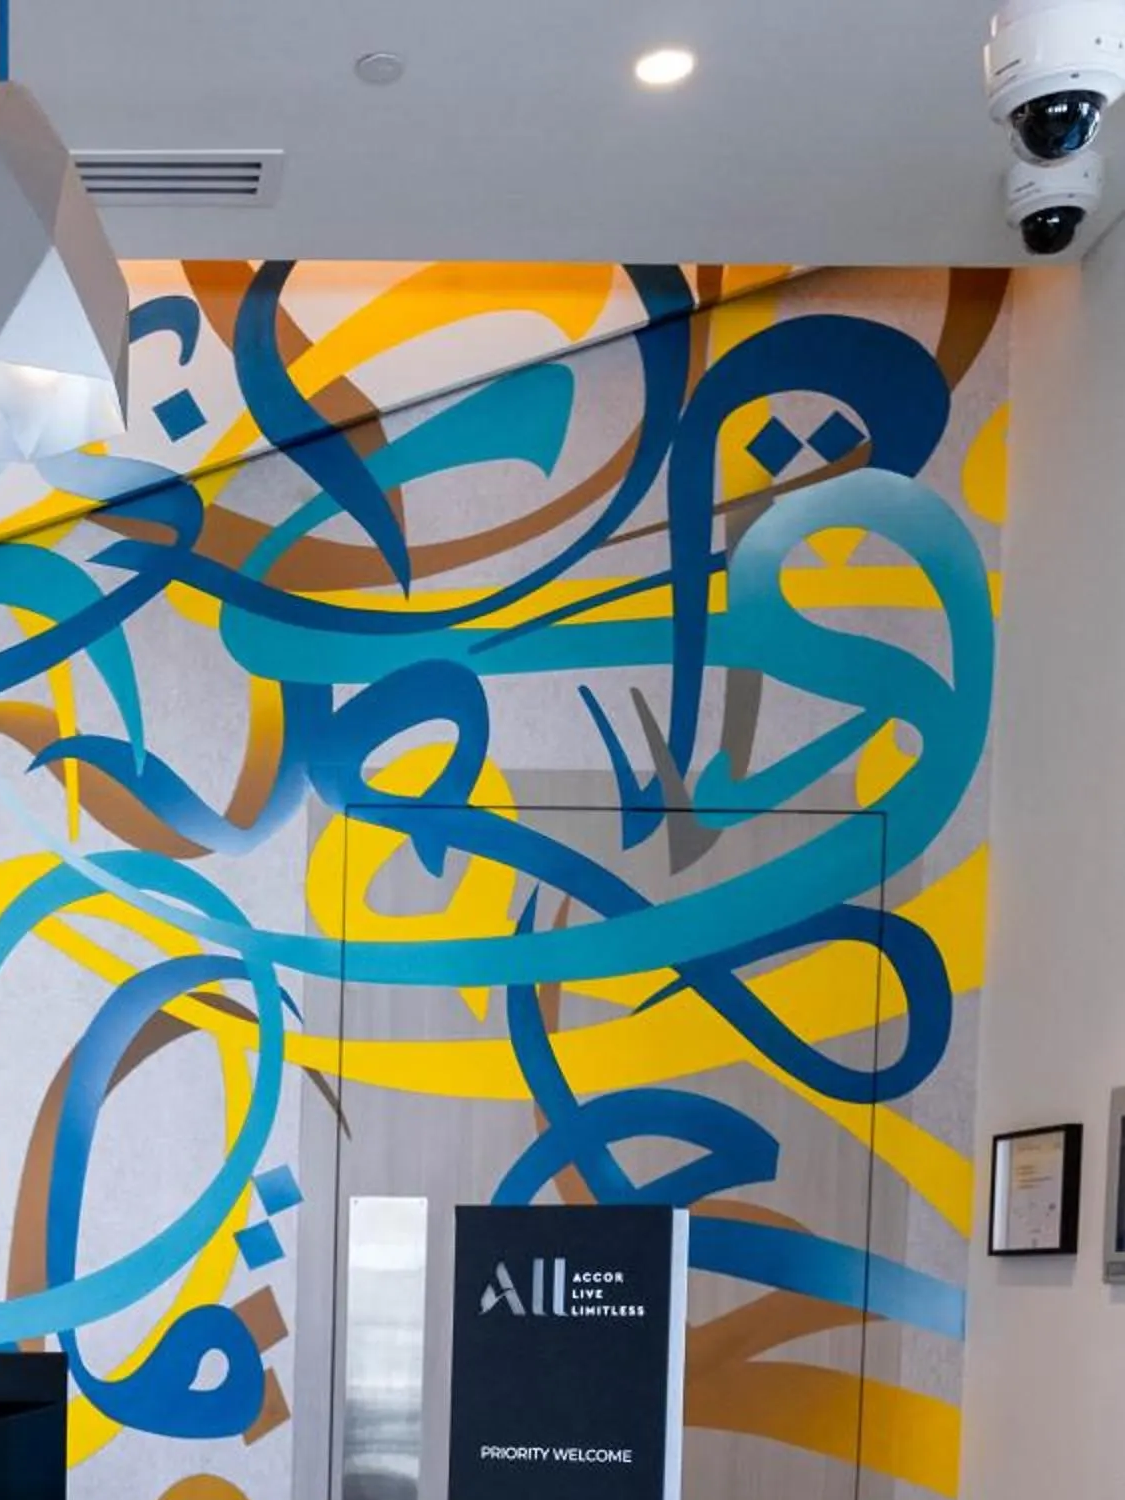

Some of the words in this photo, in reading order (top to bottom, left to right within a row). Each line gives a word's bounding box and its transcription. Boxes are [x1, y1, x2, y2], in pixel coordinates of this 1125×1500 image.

[572, 1271, 625, 1284] ACCOR
[571, 1289, 604, 1300] LIVE
[570, 1305, 646, 1318] LIMITLESS
[480, 1445, 550, 1462] PRIORITY
[551, 1447, 634, 1464] WELCOME
